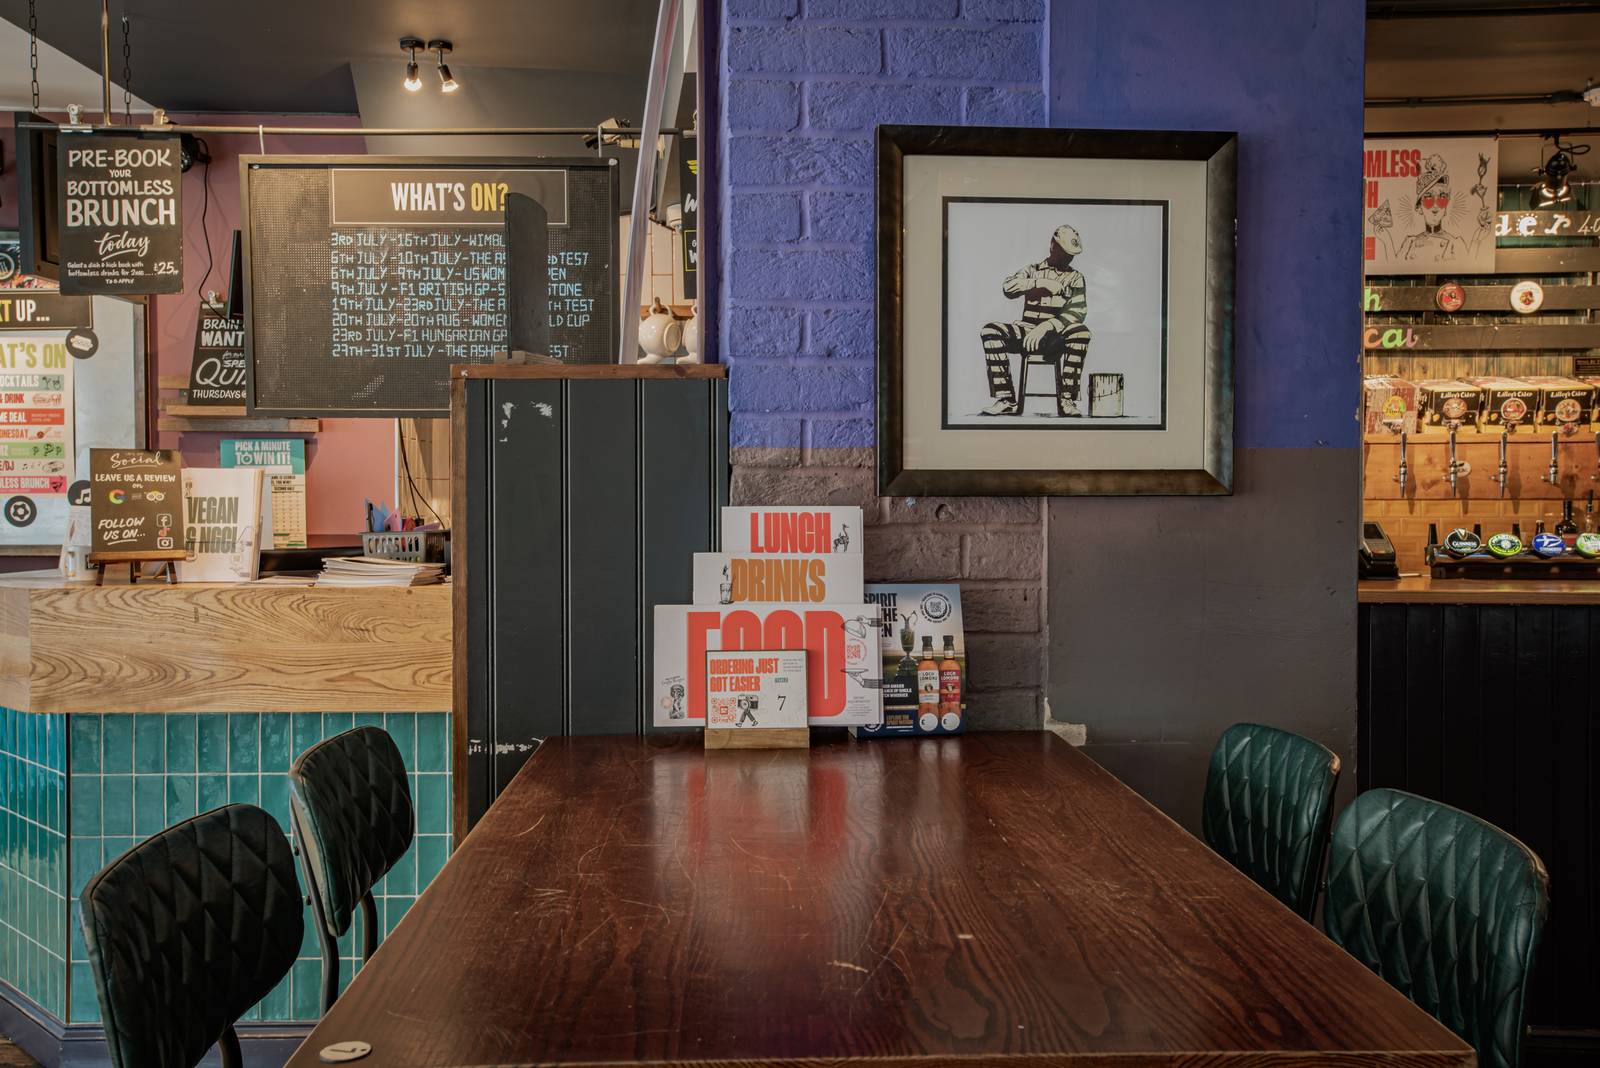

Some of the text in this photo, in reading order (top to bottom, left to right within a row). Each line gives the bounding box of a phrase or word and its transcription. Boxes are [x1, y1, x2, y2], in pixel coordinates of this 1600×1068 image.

[68, 149, 172, 168] PRE-BOOK
[1364, 149, 1422, 178] MLESS
[109, 169, 132, 178] YOUR
[67, 180, 174, 196] BOTTOMLESS
[391, 182, 509, 212] WHAT'S ON?
[67, 198, 176, 227] BRUNCH
[94, 231, 150, 257] today
[331, 232, 353, 246] 3RD
[357, 232, 388, 246] JULY
[331, 251, 354, 264] 6TH
[357, 250, 388, 264] JULY
[560, 252, 589, 265] TEST
[331, 267, 355, 280] 6TH
[356, 267, 388, 280] JULY
[331, 282, 355, 295] 9TH
[357, 282, 388, 295] JULY
[418, 282, 473, 296] BRITISH
[16, 299, 51, 322] UP...
[332, 298, 363, 311] 19TH
[564, 299, 595, 311] TEST
[332, 313, 363, 326] 20TH
[566, 314, 590, 327] CUP
[332, 329, 363, 342] 23RD
[421, 329, 490, 342] HUNGARIAN
[43, 343, 67, 369] ON
[403, 344, 435, 357] JULY
[5, 393, 25, 404] DRINK
[9, 411, 27, 423] DEAL
[235, 441, 291, 452] PICK A MINUTE
[110, 451, 163, 469] Social
[253, 451, 276, 465] WIN
[277, 451, 291, 465] IT!
[95, 473, 176, 482] LEAVE US A REVIEW
[186, 496, 239, 524] VEGAN
[98, 517, 145, 530] FOLLOW
[103, 530, 120, 541] US
[750, 512, 832, 554] LUNCH
[731, 558, 827, 603] DRINKS
[710, 659, 754, 674] ORDERING
[755, 658, 779, 673] JUST
[710, 676, 761, 692] GOT EASIER
[777, 695, 787, 711] 7
